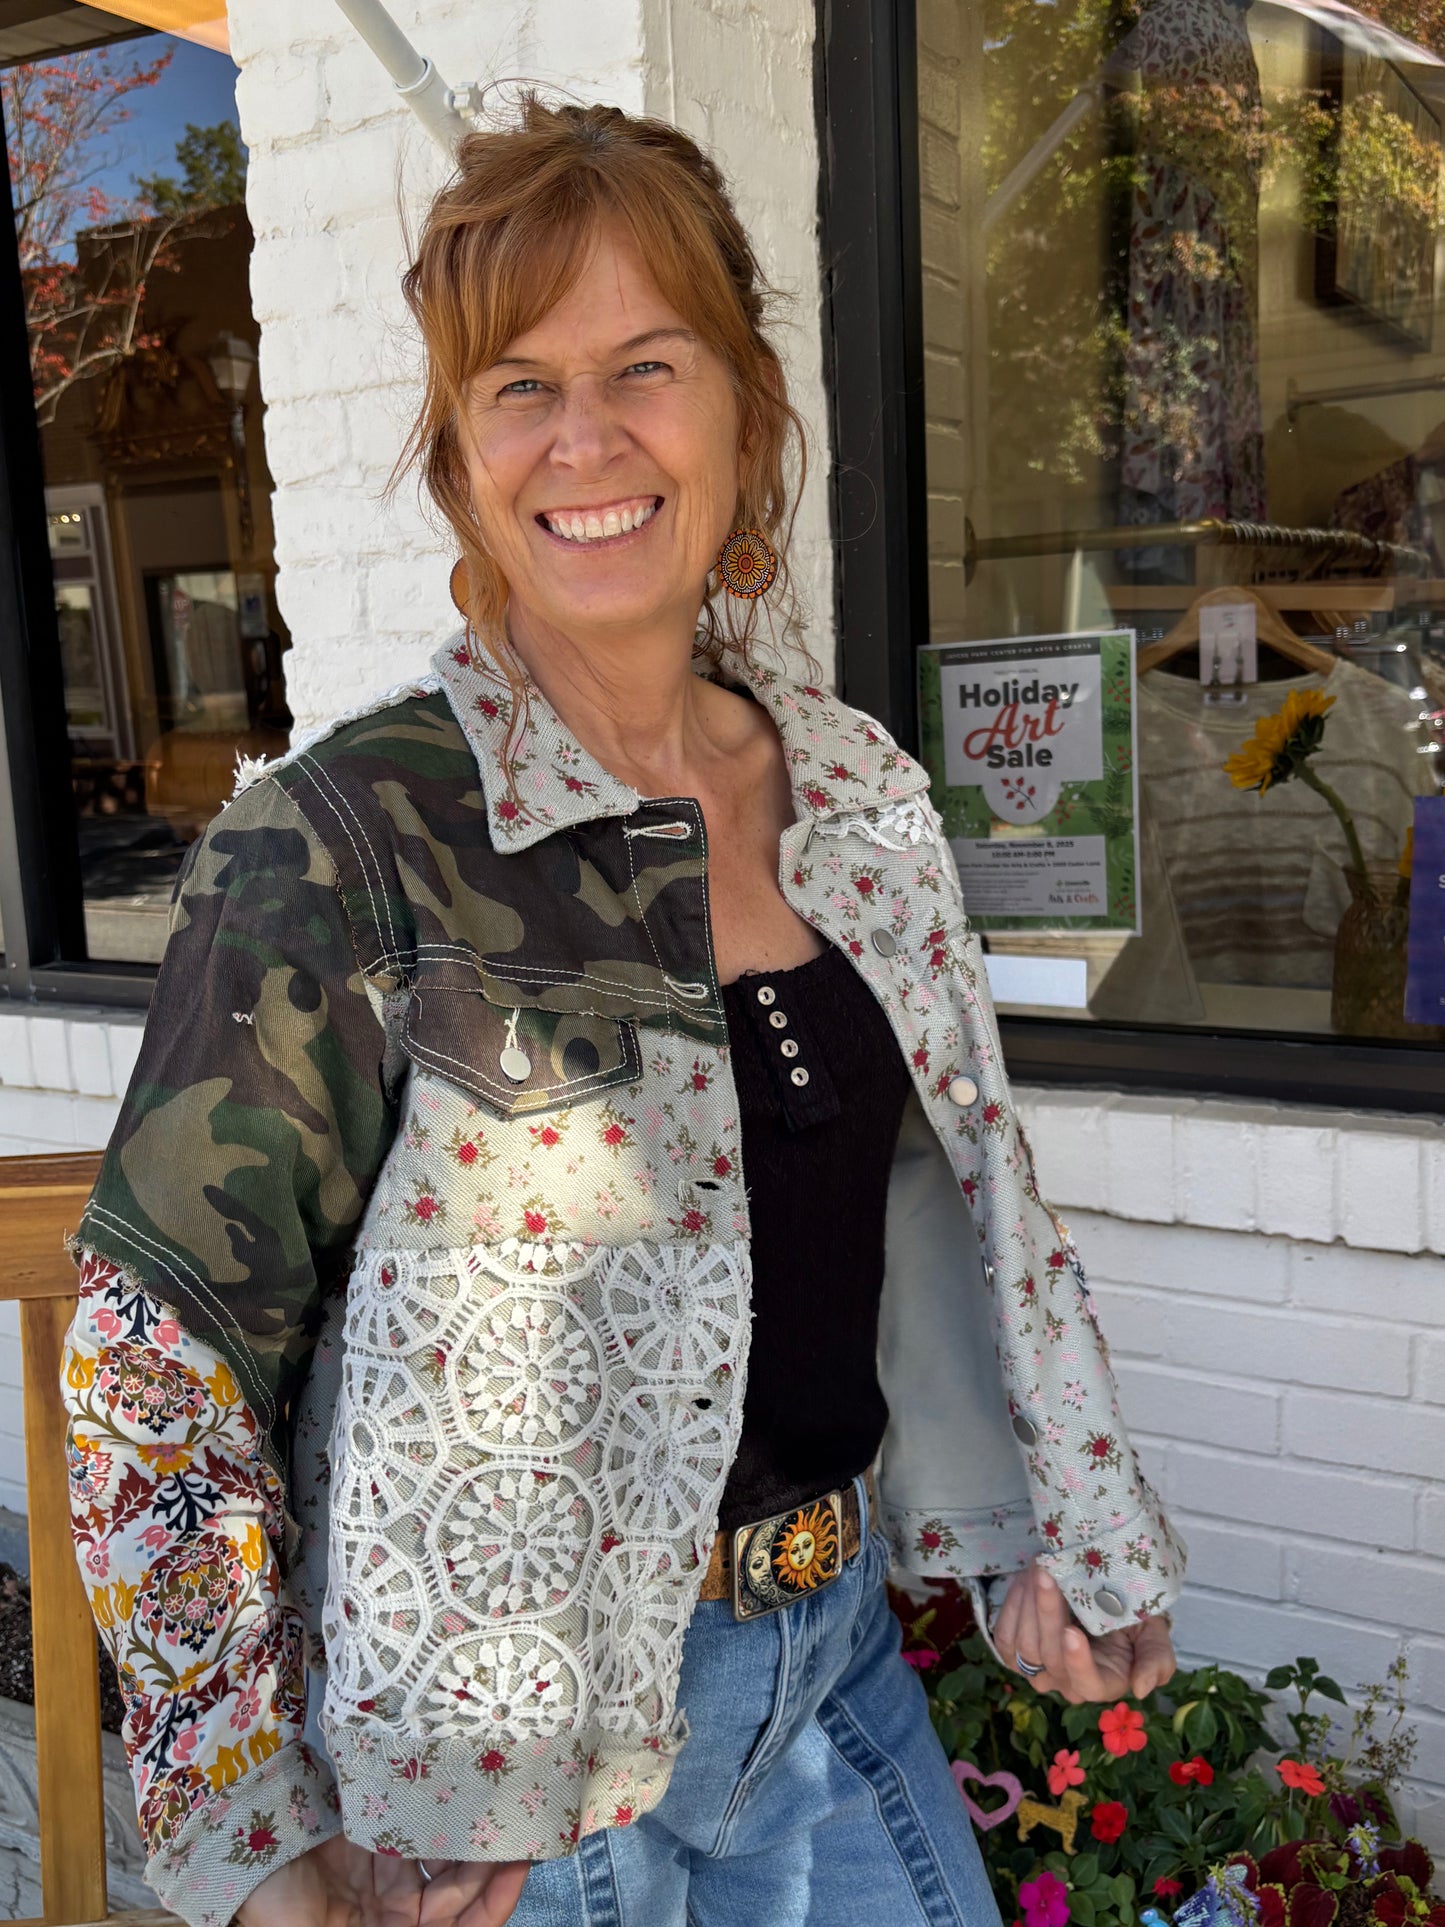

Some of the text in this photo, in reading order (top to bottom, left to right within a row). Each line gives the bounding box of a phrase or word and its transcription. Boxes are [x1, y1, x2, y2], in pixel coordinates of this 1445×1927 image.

[990, 649, 1016, 657] CENTER
[1062, 643, 1092, 651] CRAFTS
[959, 678, 1079, 709] Holiday
[963, 697, 1065, 760] Art
[986, 743, 1053, 769] Sale
